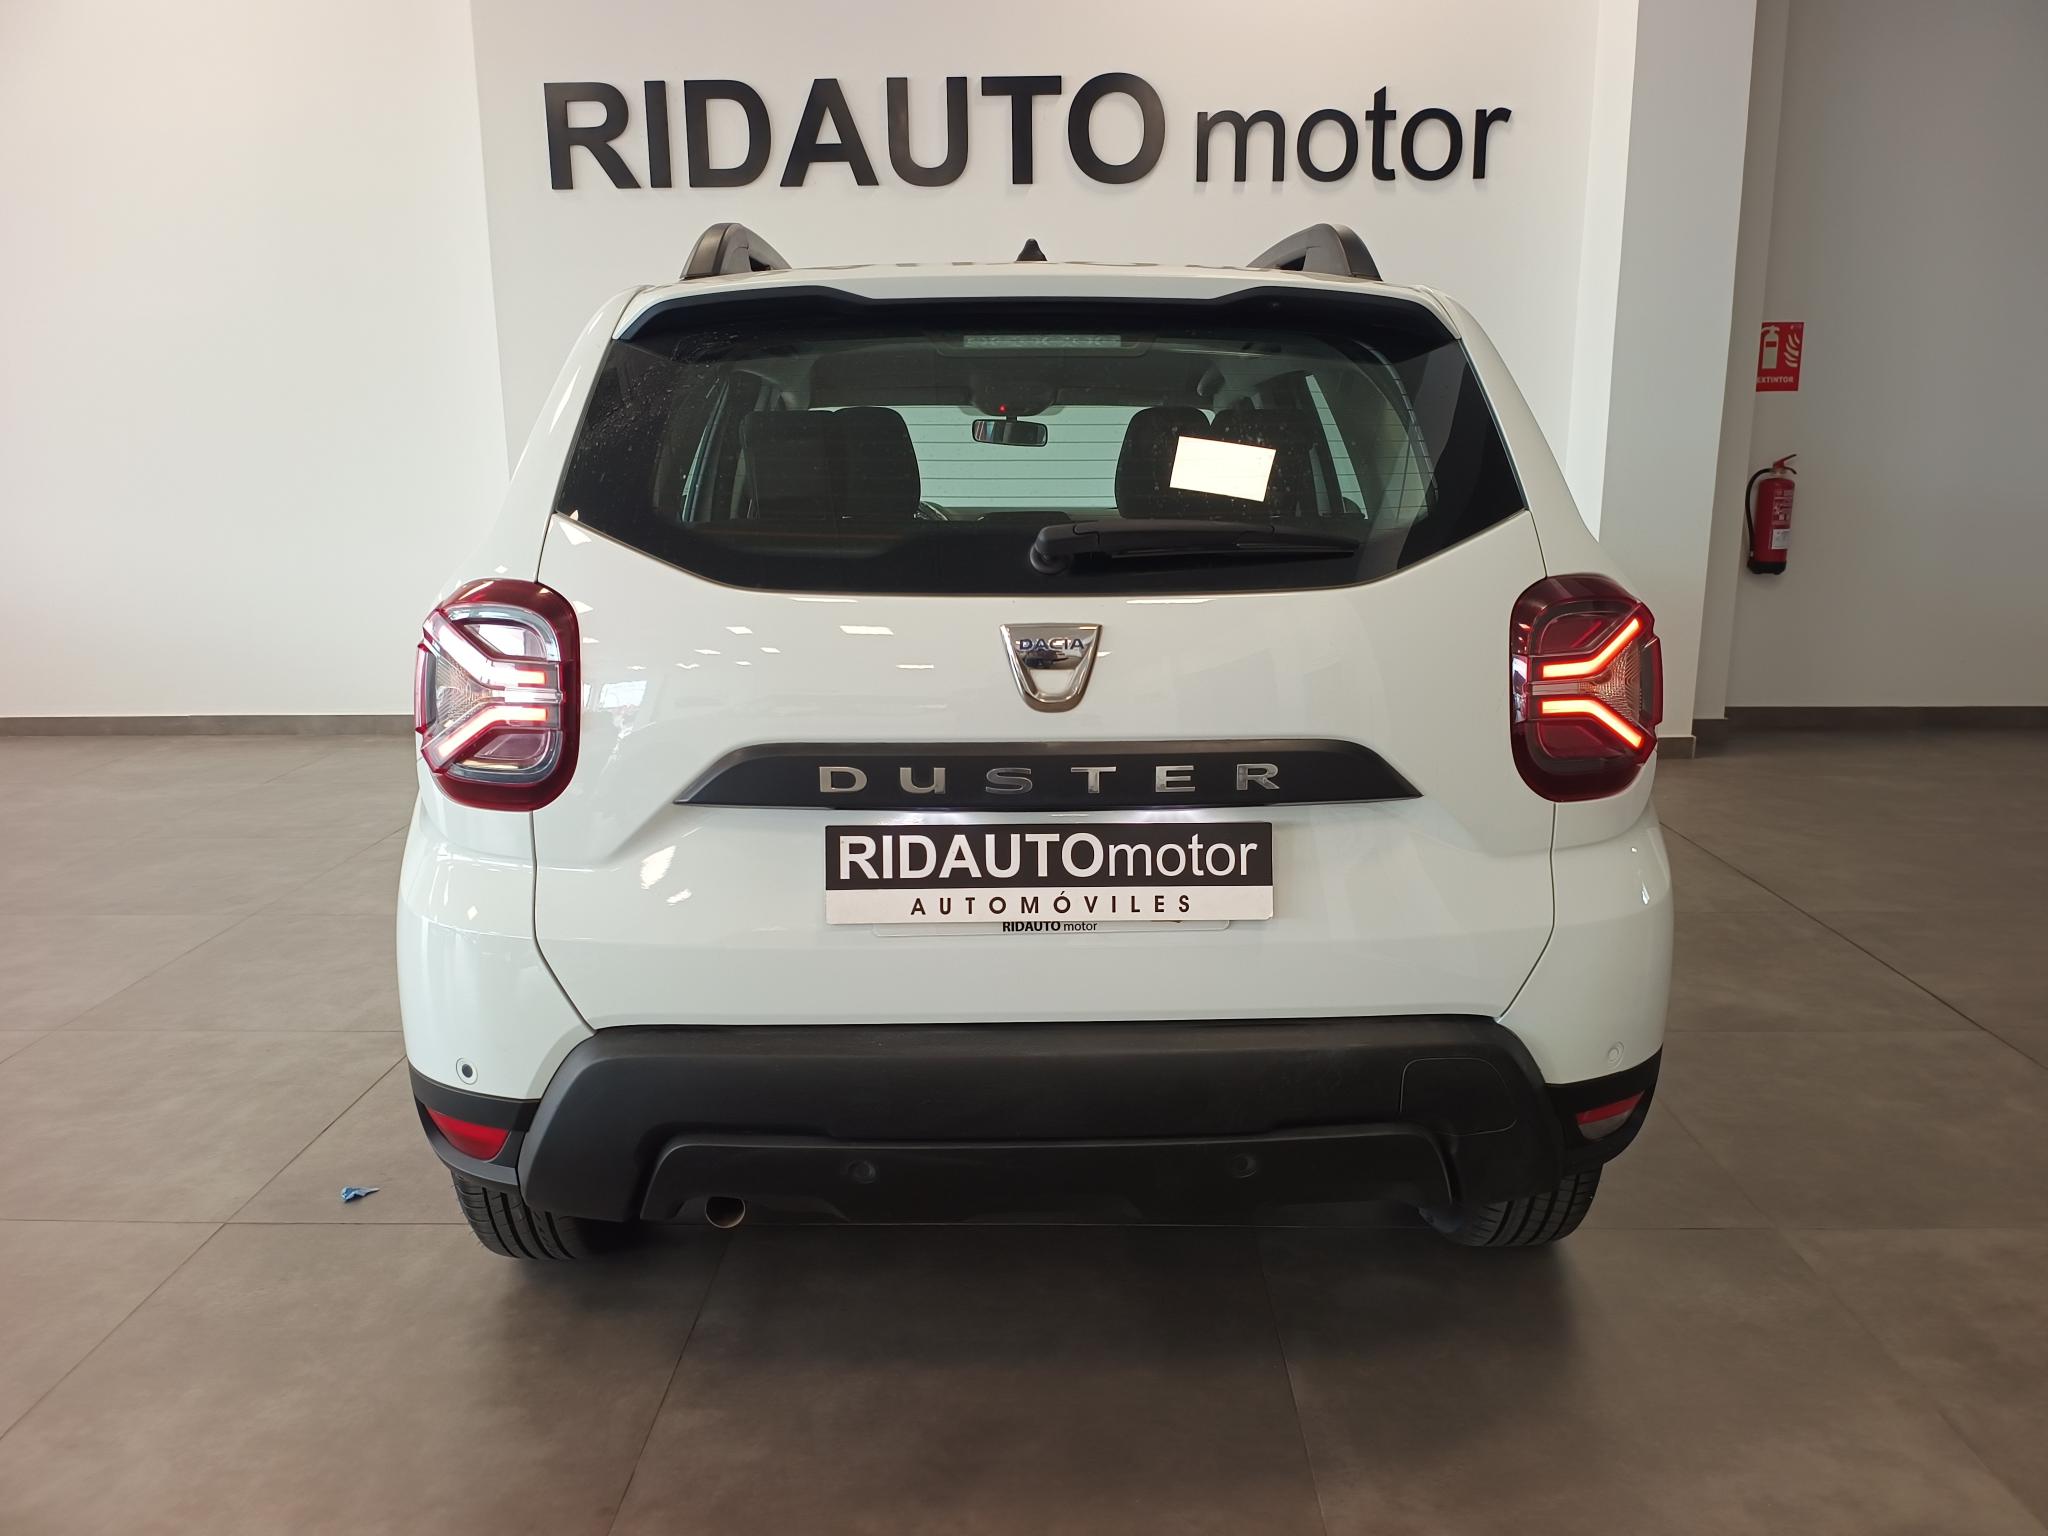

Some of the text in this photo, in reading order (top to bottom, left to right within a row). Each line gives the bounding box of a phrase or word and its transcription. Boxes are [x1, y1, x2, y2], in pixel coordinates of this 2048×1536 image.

[543, 73, 1512, 190] RIDAUTO motor
[1019, 638, 1084, 650] DACIA
[819, 763, 1280, 793] DUSTER
[839, 832, 1258, 880] RIDAUTOmotor
[910, 891, 1191, 915] AUTOMÓVILES
[1002, 921, 1098, 932] RIDAUTO motor
